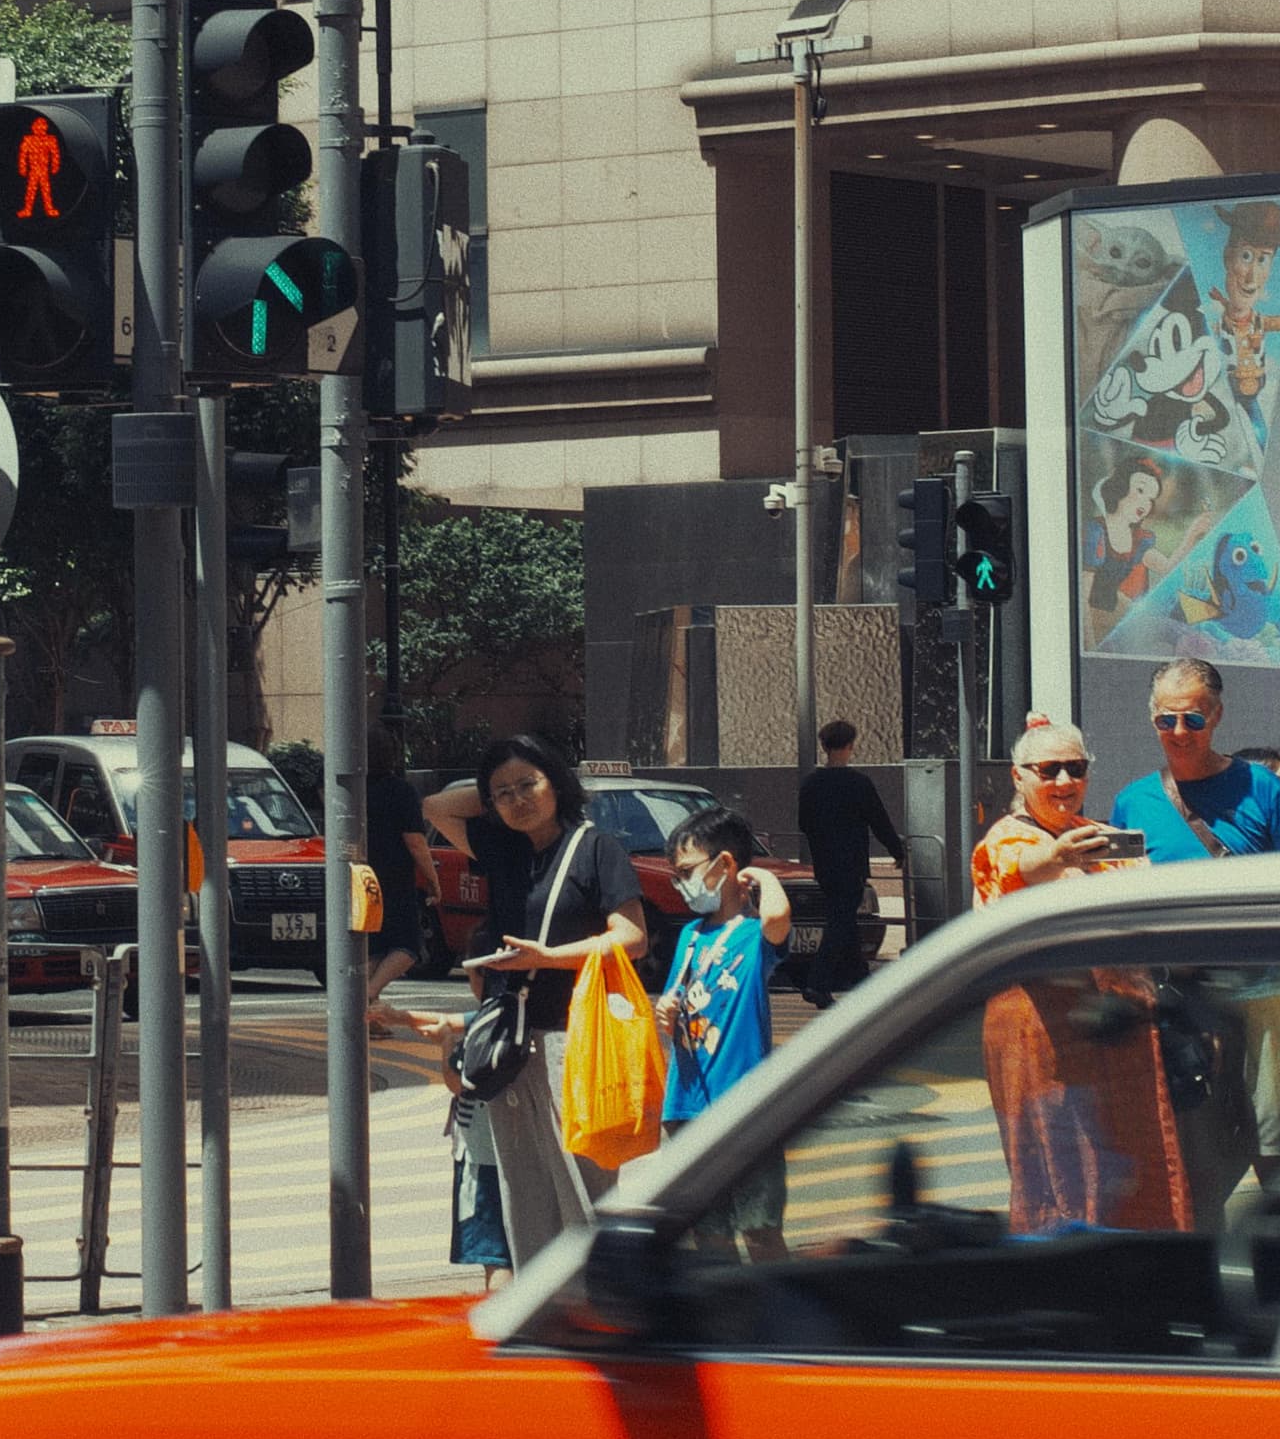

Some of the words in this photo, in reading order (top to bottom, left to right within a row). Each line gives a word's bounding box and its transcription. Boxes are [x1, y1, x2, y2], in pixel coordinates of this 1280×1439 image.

[121, 316, 132, 336] 6
[327, 334, 337, 352] 2
[275, 926, 314, 940] 3273
